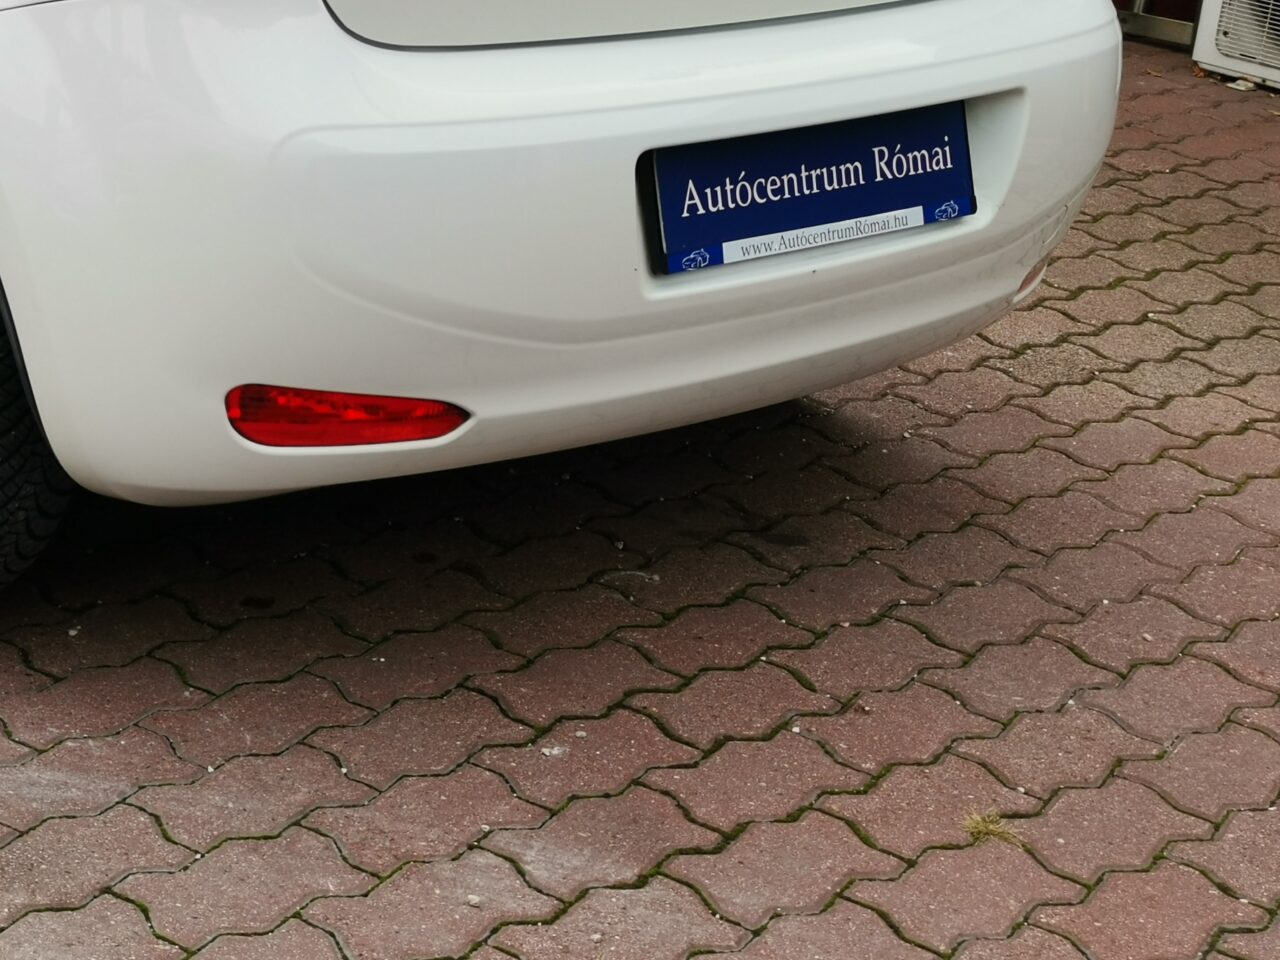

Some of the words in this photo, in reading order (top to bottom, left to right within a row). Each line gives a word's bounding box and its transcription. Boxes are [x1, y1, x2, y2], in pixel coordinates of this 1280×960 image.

[681, 160, 866, 218] Autócentrum
[872, 135, 954, 183] Római
[740, 213, 909, 258] www.AutócentrumRómai.hu
